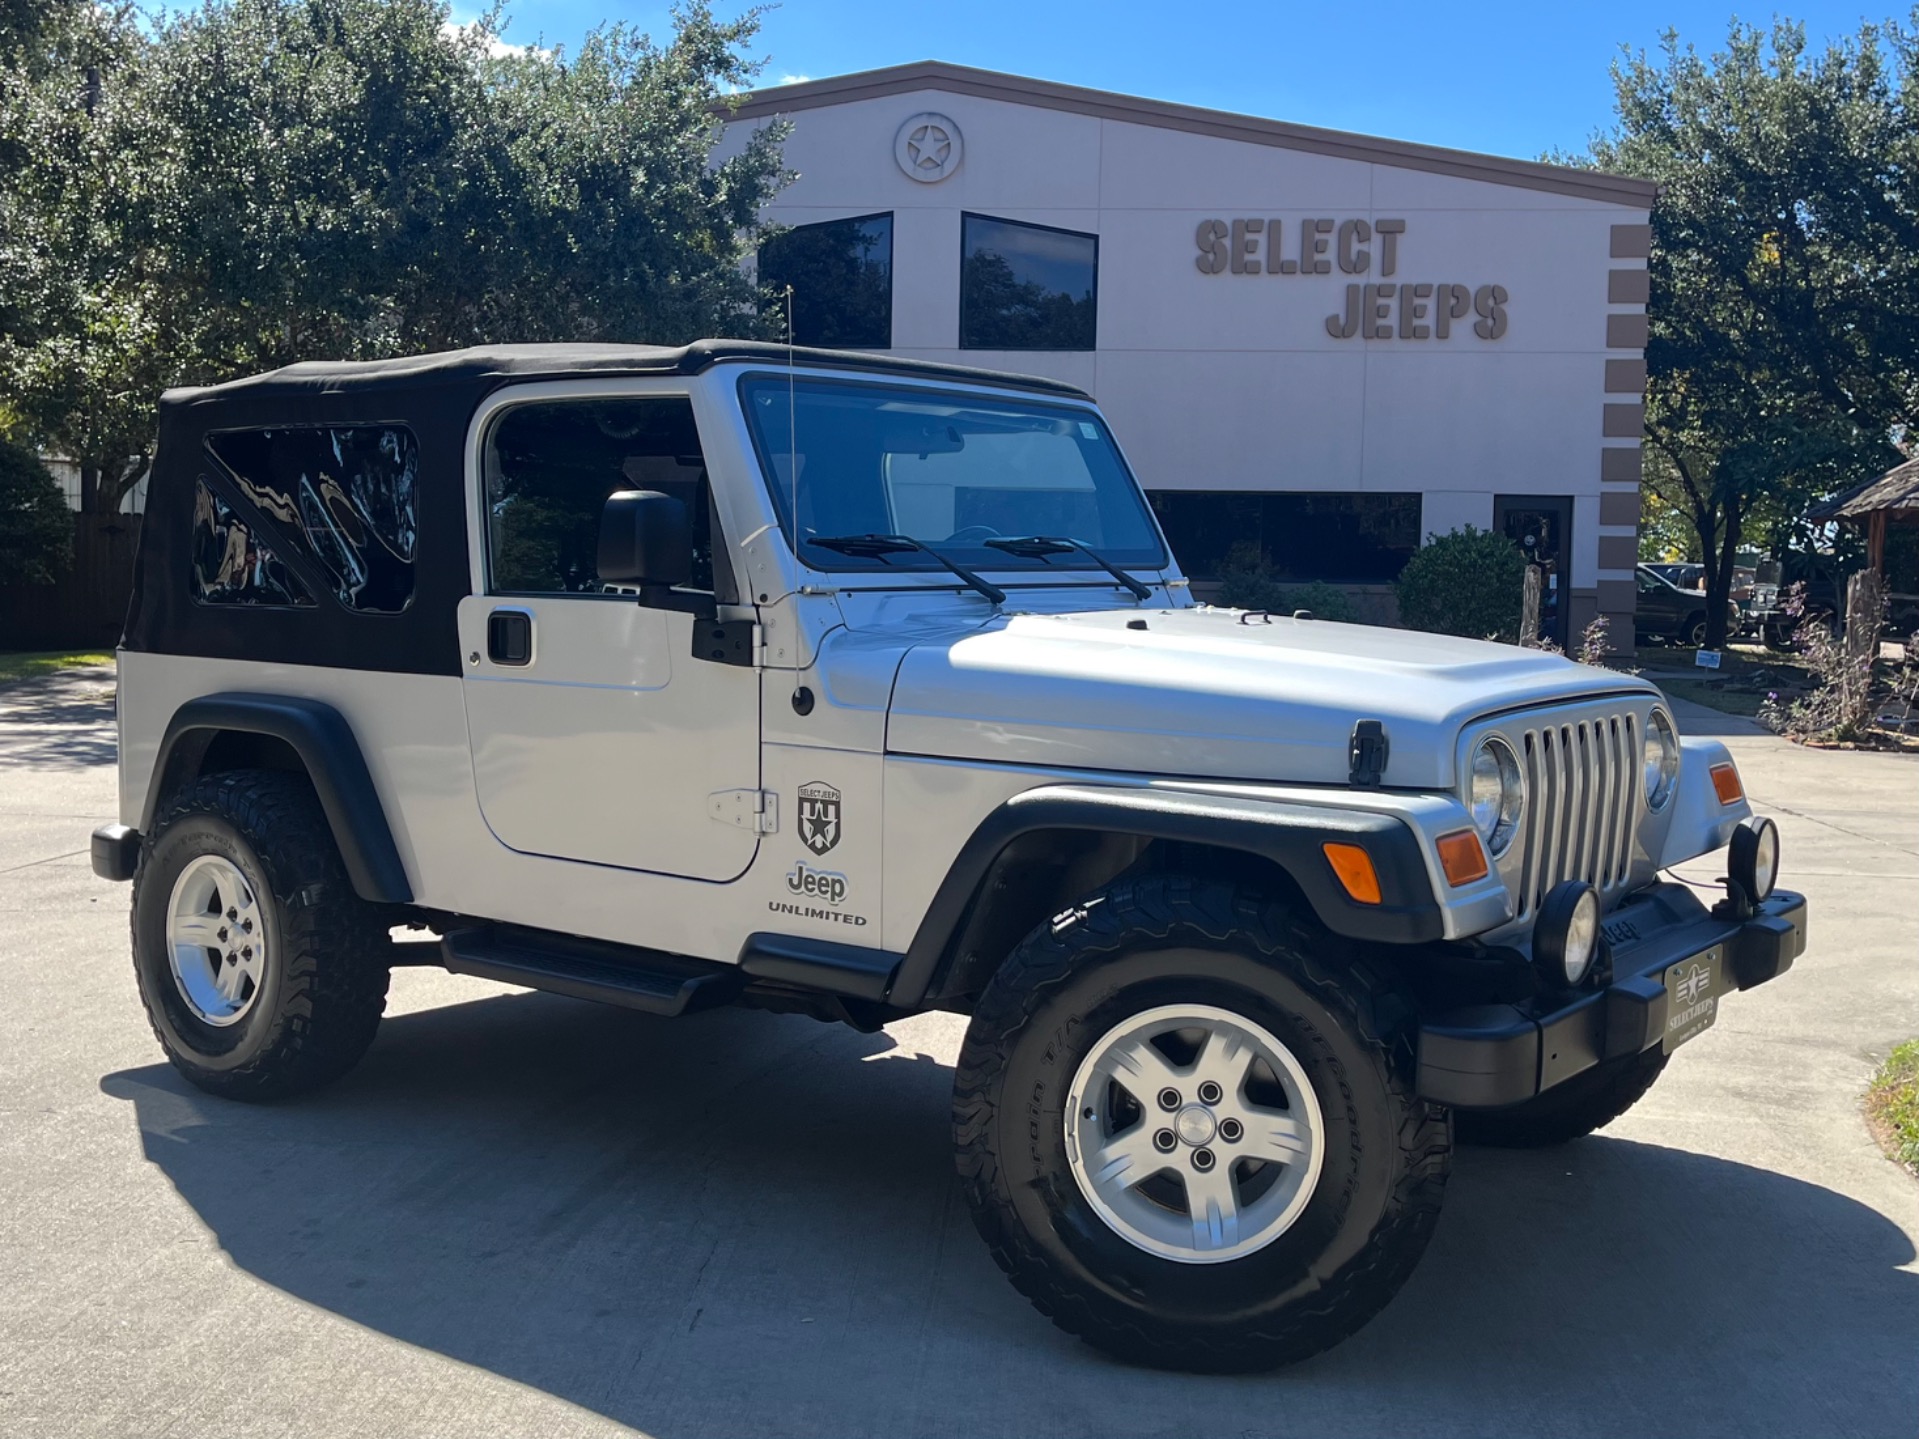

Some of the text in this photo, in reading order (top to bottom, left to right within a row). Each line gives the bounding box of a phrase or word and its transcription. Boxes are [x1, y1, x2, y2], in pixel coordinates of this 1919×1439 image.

[1195, 218, 1406, 277] SELECT
[1325, 283, 1508, 340] JEEPS
[800, 788, 840, 800] SELECT JEEPS
[788, 865, 845, 902] Jeep
[768, 901, 867, 926] UNLIMITED
